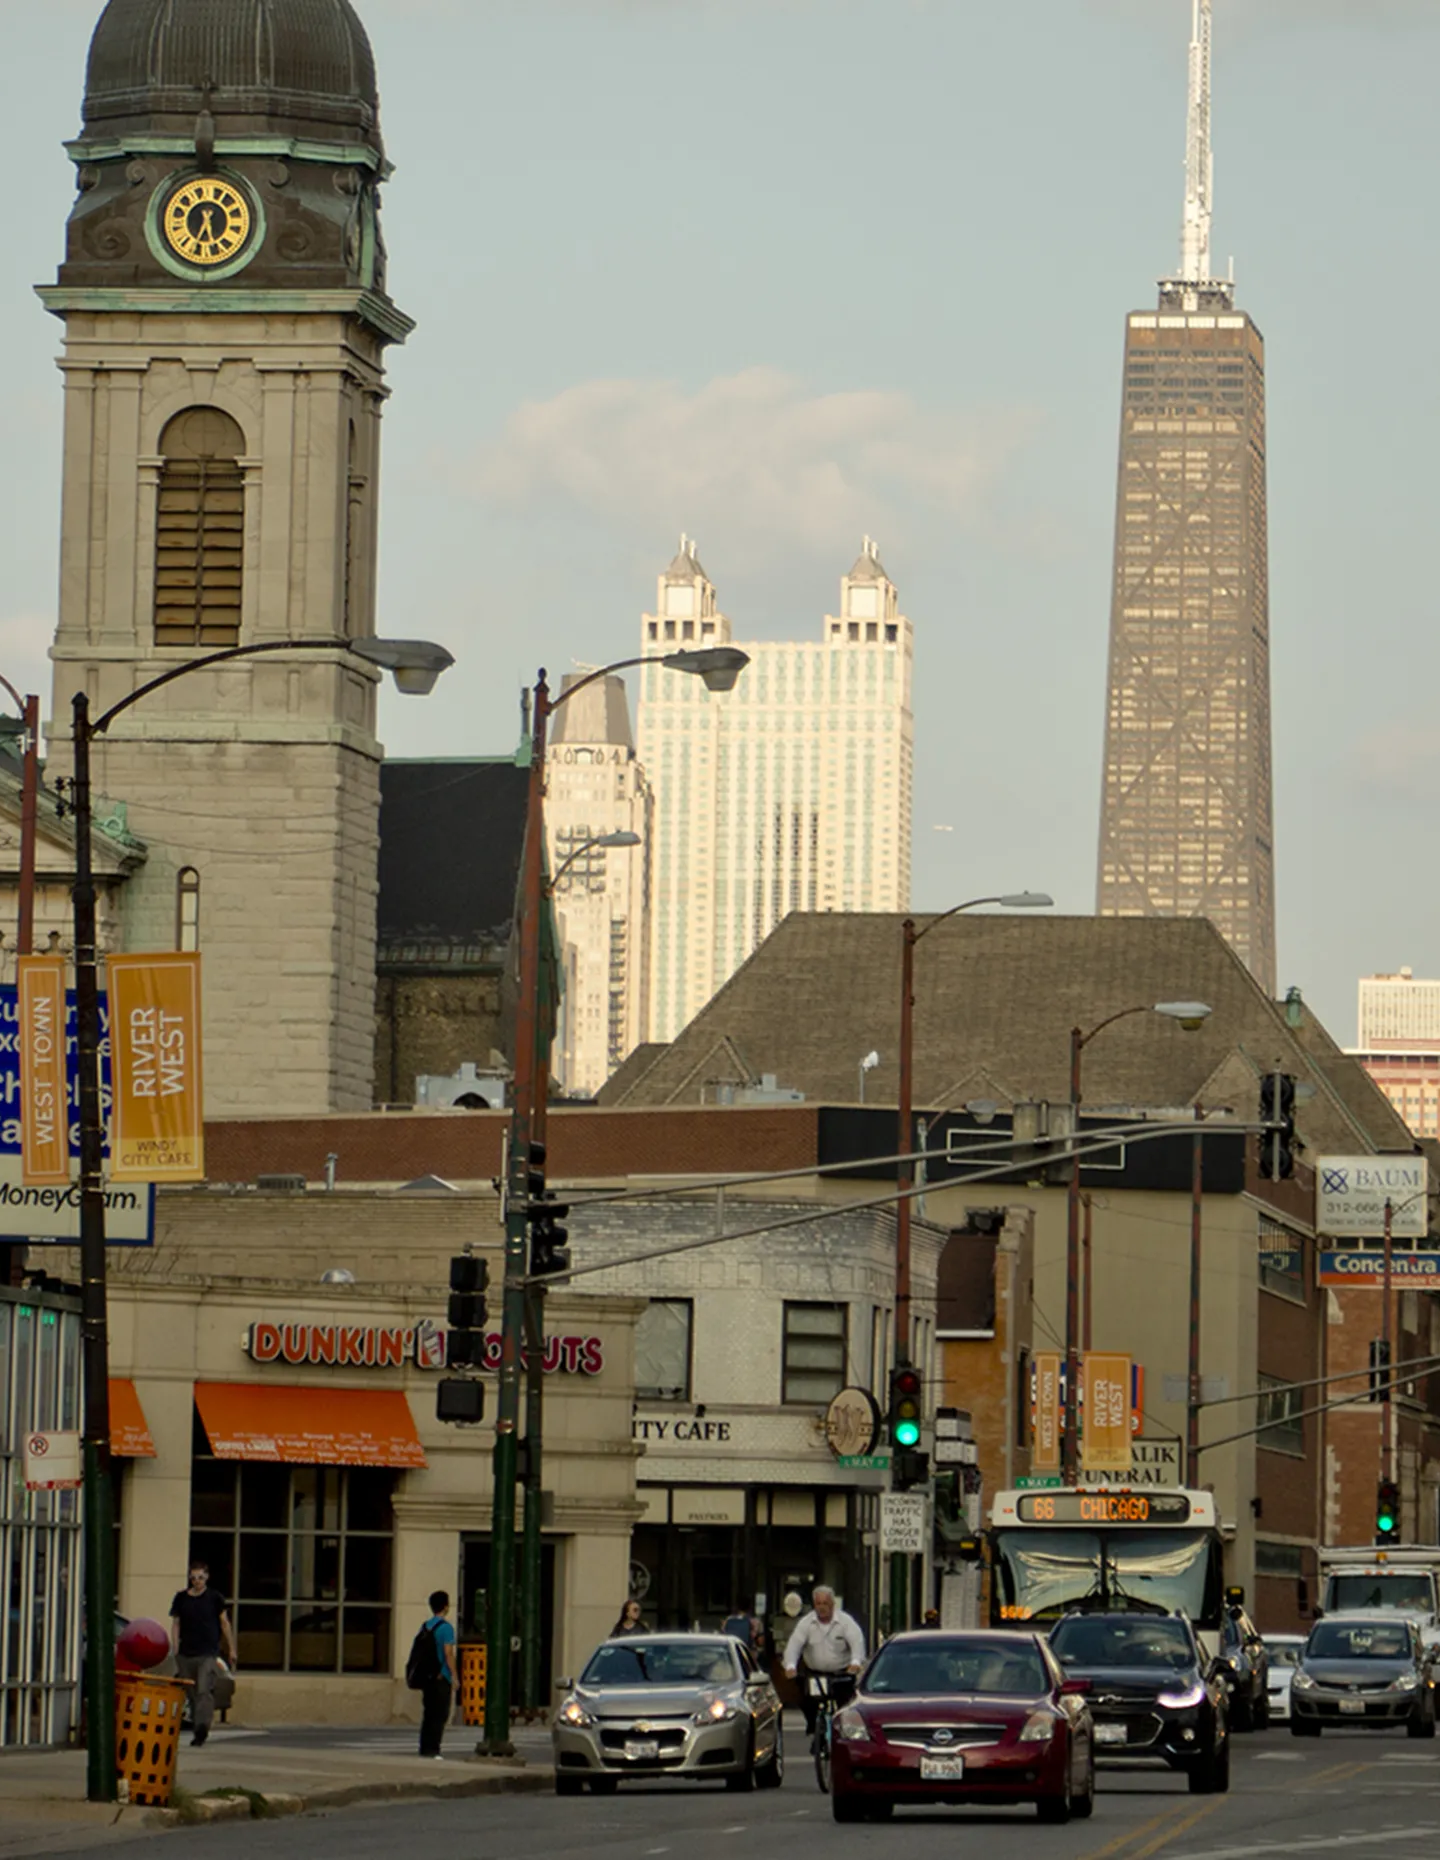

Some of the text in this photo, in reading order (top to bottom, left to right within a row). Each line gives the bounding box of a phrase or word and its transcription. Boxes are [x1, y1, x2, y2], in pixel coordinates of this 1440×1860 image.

[130, 1007, 156, 1097] RIVER
[159, 1010, 184, 1096] WEST
[33, 996, 54, 1145] WEST TOWN
[135, 1140, 178, 1151] WINDY
[122, 1153, 192, 1167] CITY CAFE
[1356, 1169, 1419, 1187] BAUM
[252, 1323, 606, 1375] DUNKIN' OUTS
[1094, 1380, 1108, 1427] RIVER
[1110, 1383, 1123, 1427] WEST
[632, 1421, 730, 1441] ITY CAFE
[852, 1457, 875, 1468] MAY
[1027, 1479, 1048, 1487] MAY
[884, 1507, 922, 1516] TRAFFIC
[1033, 1498, 1149, 1520] 66 CHICAGO
[892, 1517, 912, 1526] HAS
[884, 1528, 920, 1537] LONGER
[886, 1538, 918, 1547] GREEN
